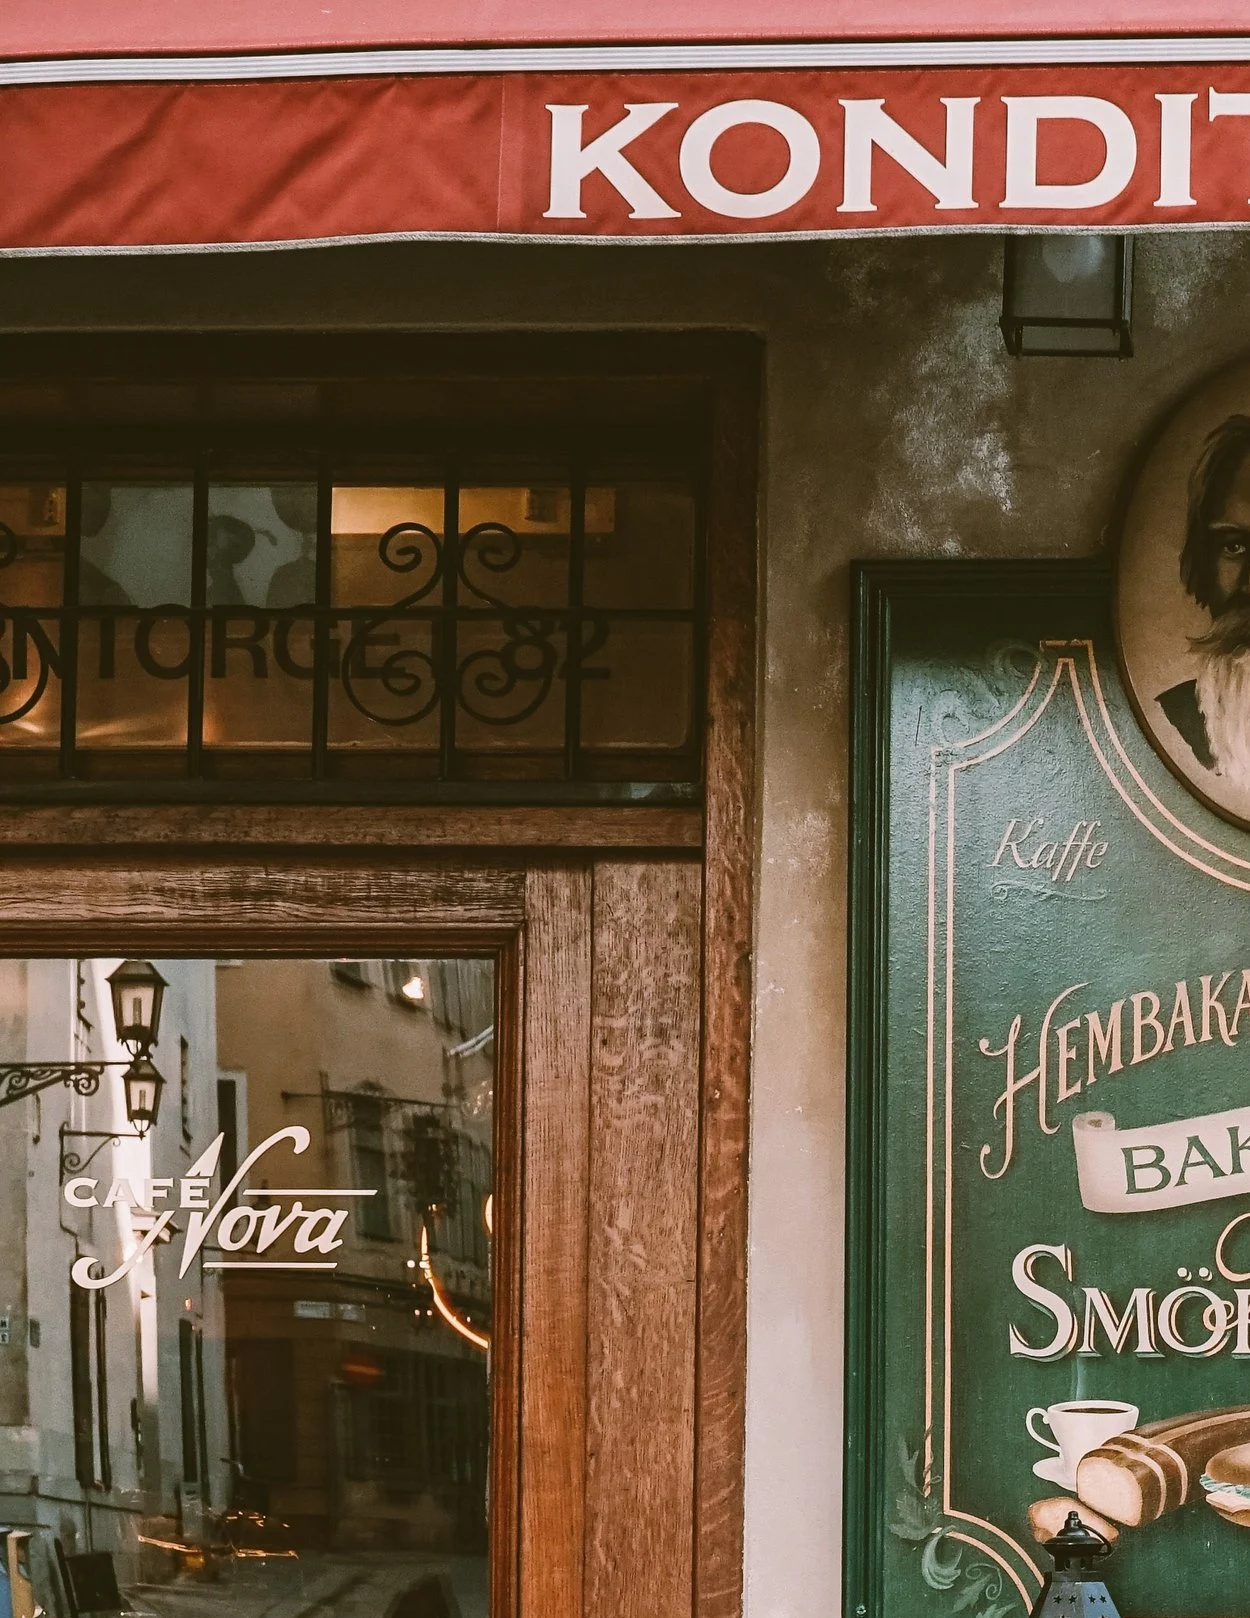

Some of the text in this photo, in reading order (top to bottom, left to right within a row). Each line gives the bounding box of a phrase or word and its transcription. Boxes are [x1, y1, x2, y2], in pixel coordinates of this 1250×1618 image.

[500, 605, 612, 680] 82
[986, 817, 1110, 882] Kaffe
[71, 1125, 349, 1289] Nova
